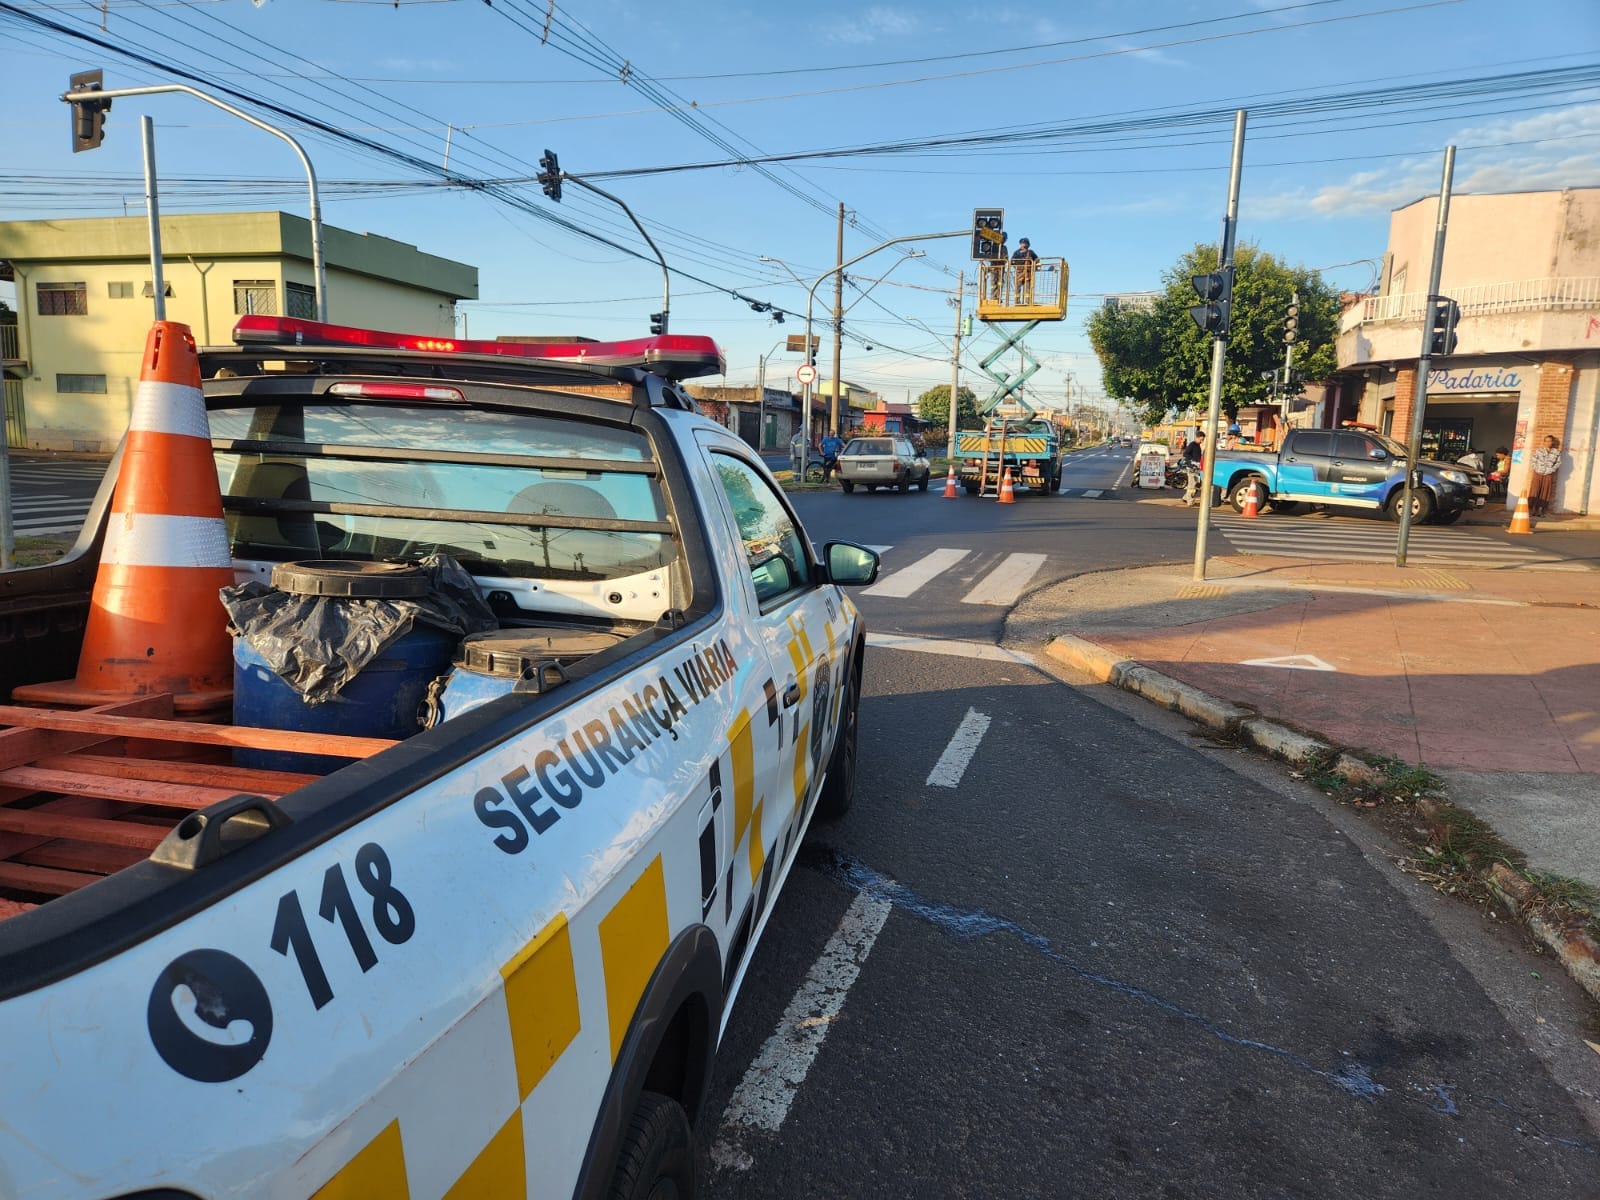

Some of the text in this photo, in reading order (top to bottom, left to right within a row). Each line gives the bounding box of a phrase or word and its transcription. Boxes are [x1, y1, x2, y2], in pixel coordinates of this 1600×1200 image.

[1427, 368, 1521, 389] Padaria
[473, 677, 689, 854] SEGURANÇA
[673, 639, 739, 705] VIÁRIA
[270, 842, 416, 1010] 118
